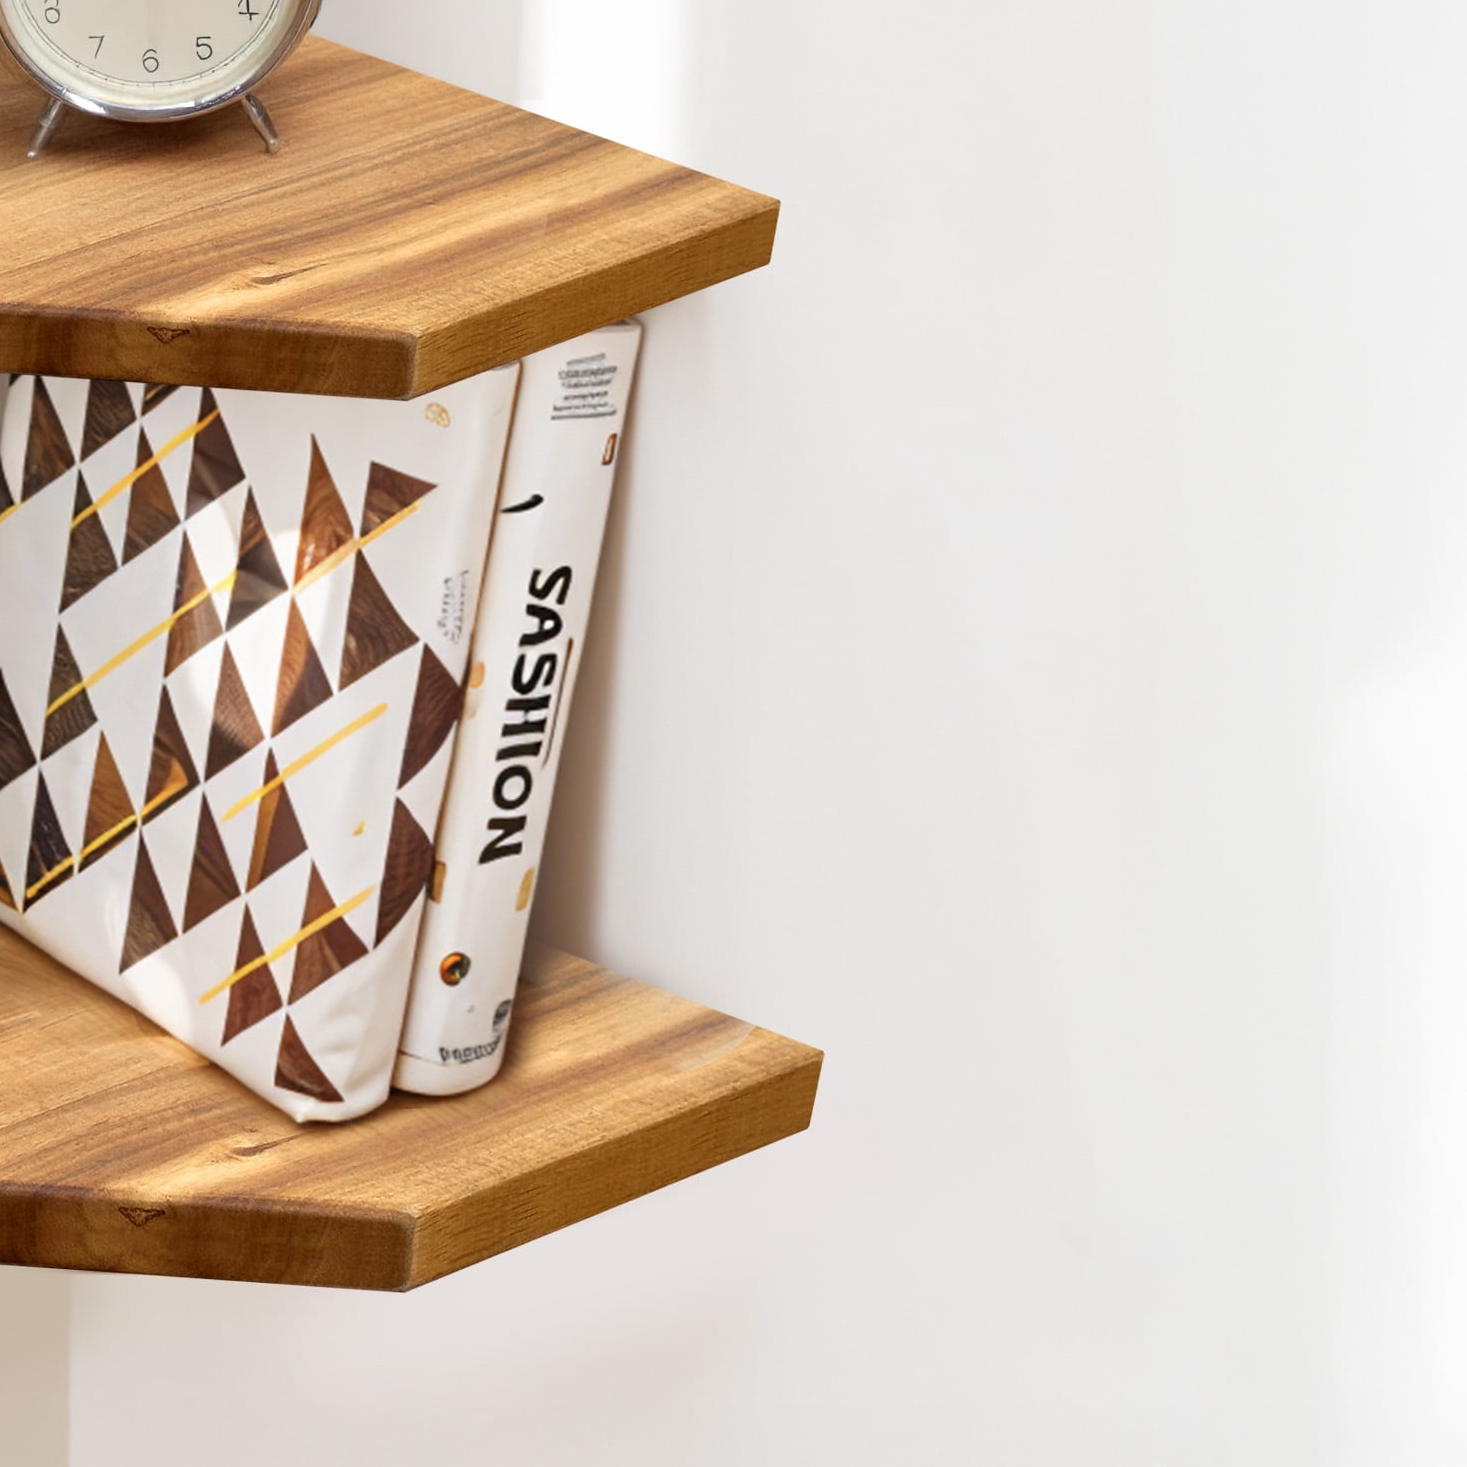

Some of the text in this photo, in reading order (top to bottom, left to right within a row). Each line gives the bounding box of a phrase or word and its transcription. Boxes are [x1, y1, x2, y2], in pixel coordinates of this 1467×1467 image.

[88, 35, 105, 59] 7
[195, 35, 214, 61] 5
[141, 48, 160, 73] 6
[477, 565, 573, 866] SASHION
